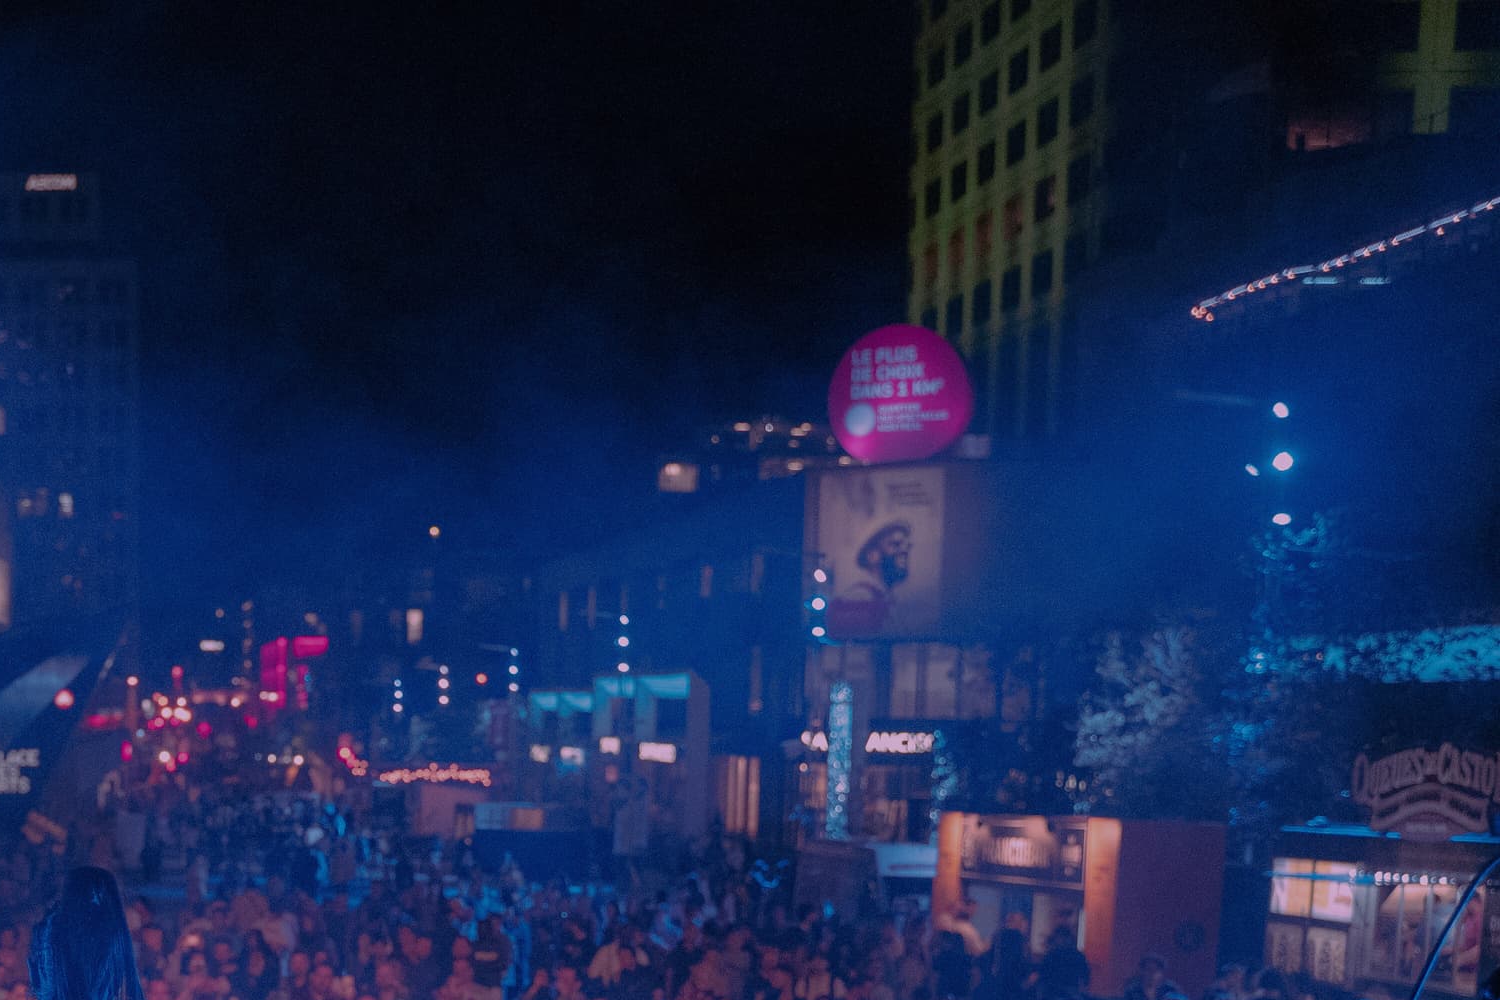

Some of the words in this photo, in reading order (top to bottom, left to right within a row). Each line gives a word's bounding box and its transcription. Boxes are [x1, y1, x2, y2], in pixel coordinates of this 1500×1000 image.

[851, 348, 872, 366] LE
[875, 345, 918, 364] PLUS
[851, 381, 893, 400] DANS
